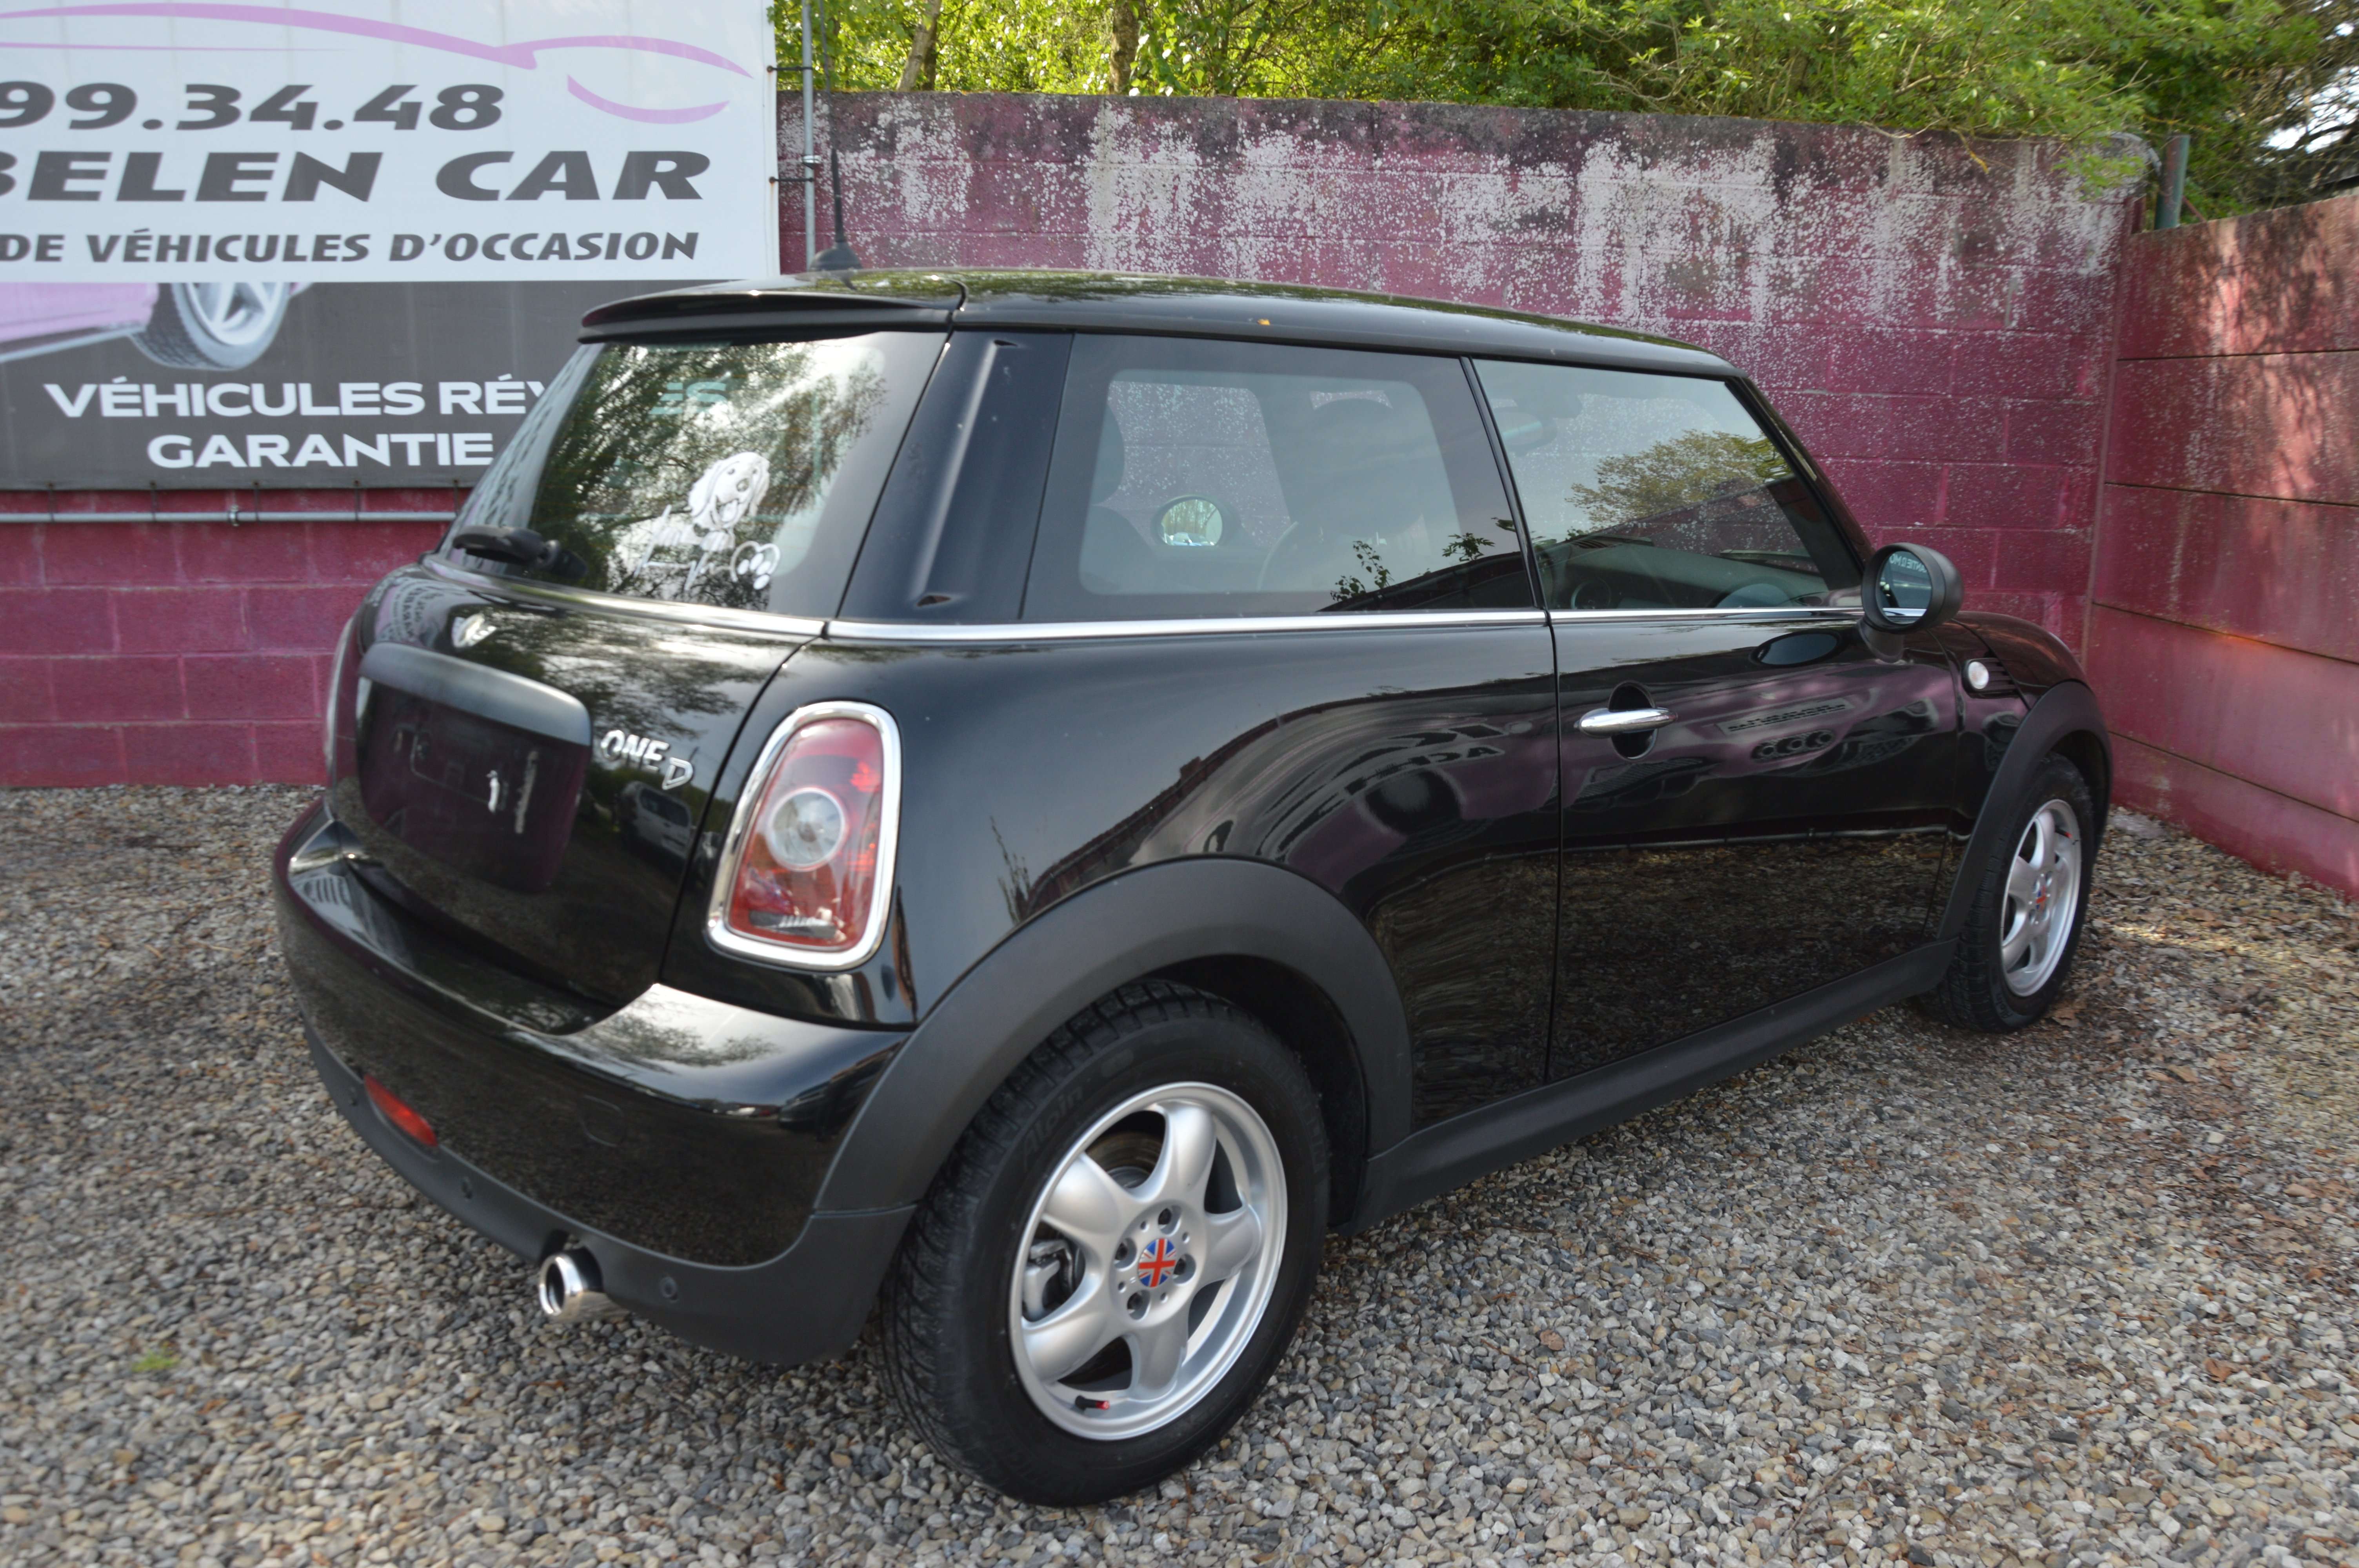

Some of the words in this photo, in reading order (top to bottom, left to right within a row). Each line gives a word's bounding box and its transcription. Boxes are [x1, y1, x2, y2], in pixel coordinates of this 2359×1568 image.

[436, 150, 711, 201] CAR
[0, 234, 65, 262] DE
[85, 228, 371, 262] VÉHICULES
[389, 231, 699, 261] D'OCCASION
[42, 375, 426, 418] VÉHICULES
[147, 432, 494, 469] GARANTIE
[600, 730, 670, 772] ONE
[662, 757, 694, 790] D
